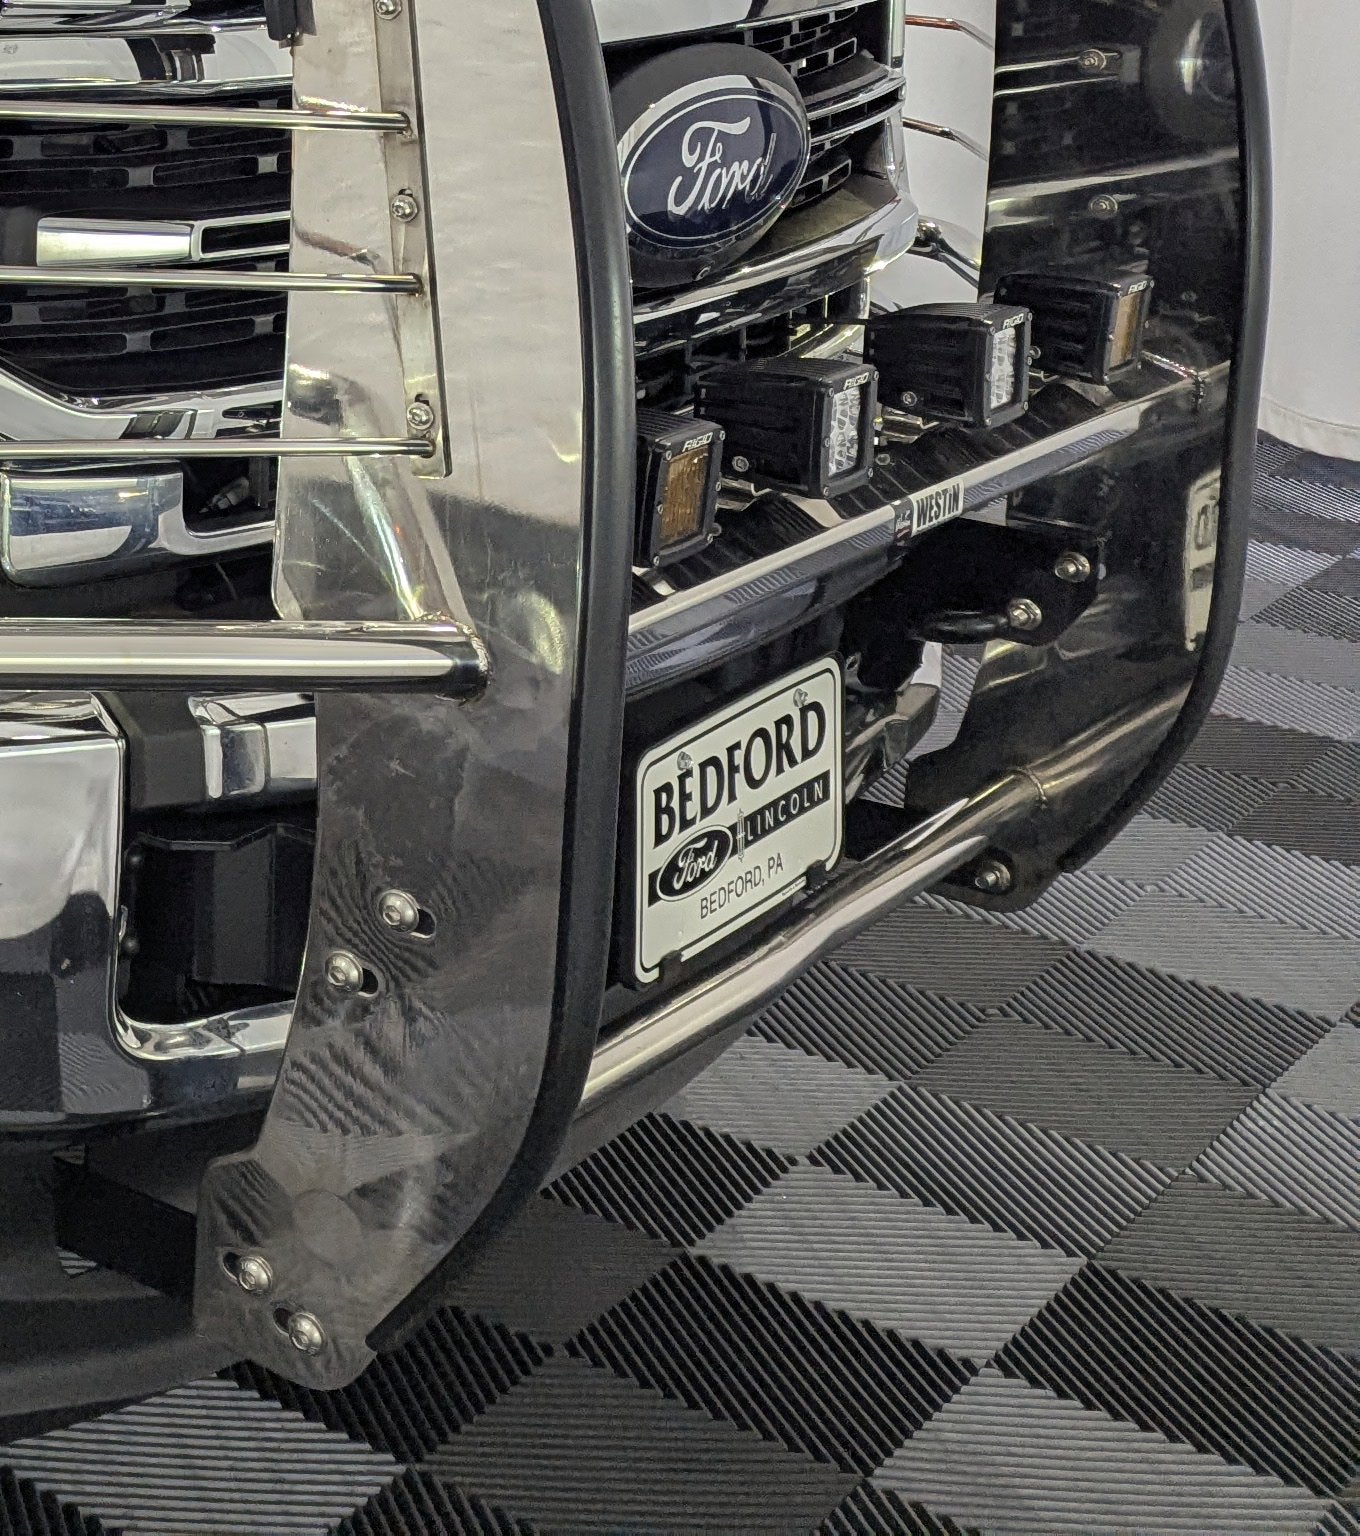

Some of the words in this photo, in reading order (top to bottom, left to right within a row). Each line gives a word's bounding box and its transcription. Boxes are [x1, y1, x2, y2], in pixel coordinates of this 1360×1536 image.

[666, 116, 778, 220] Ford
[652, 699, 827, 849] BEDFORD
[673, 840, 719, 890] Ford
[745, 780, 825, 841] LINCOLN
[699, 864, 766, 920] BEDFORD,
[767, 851, 785, 882] PA
